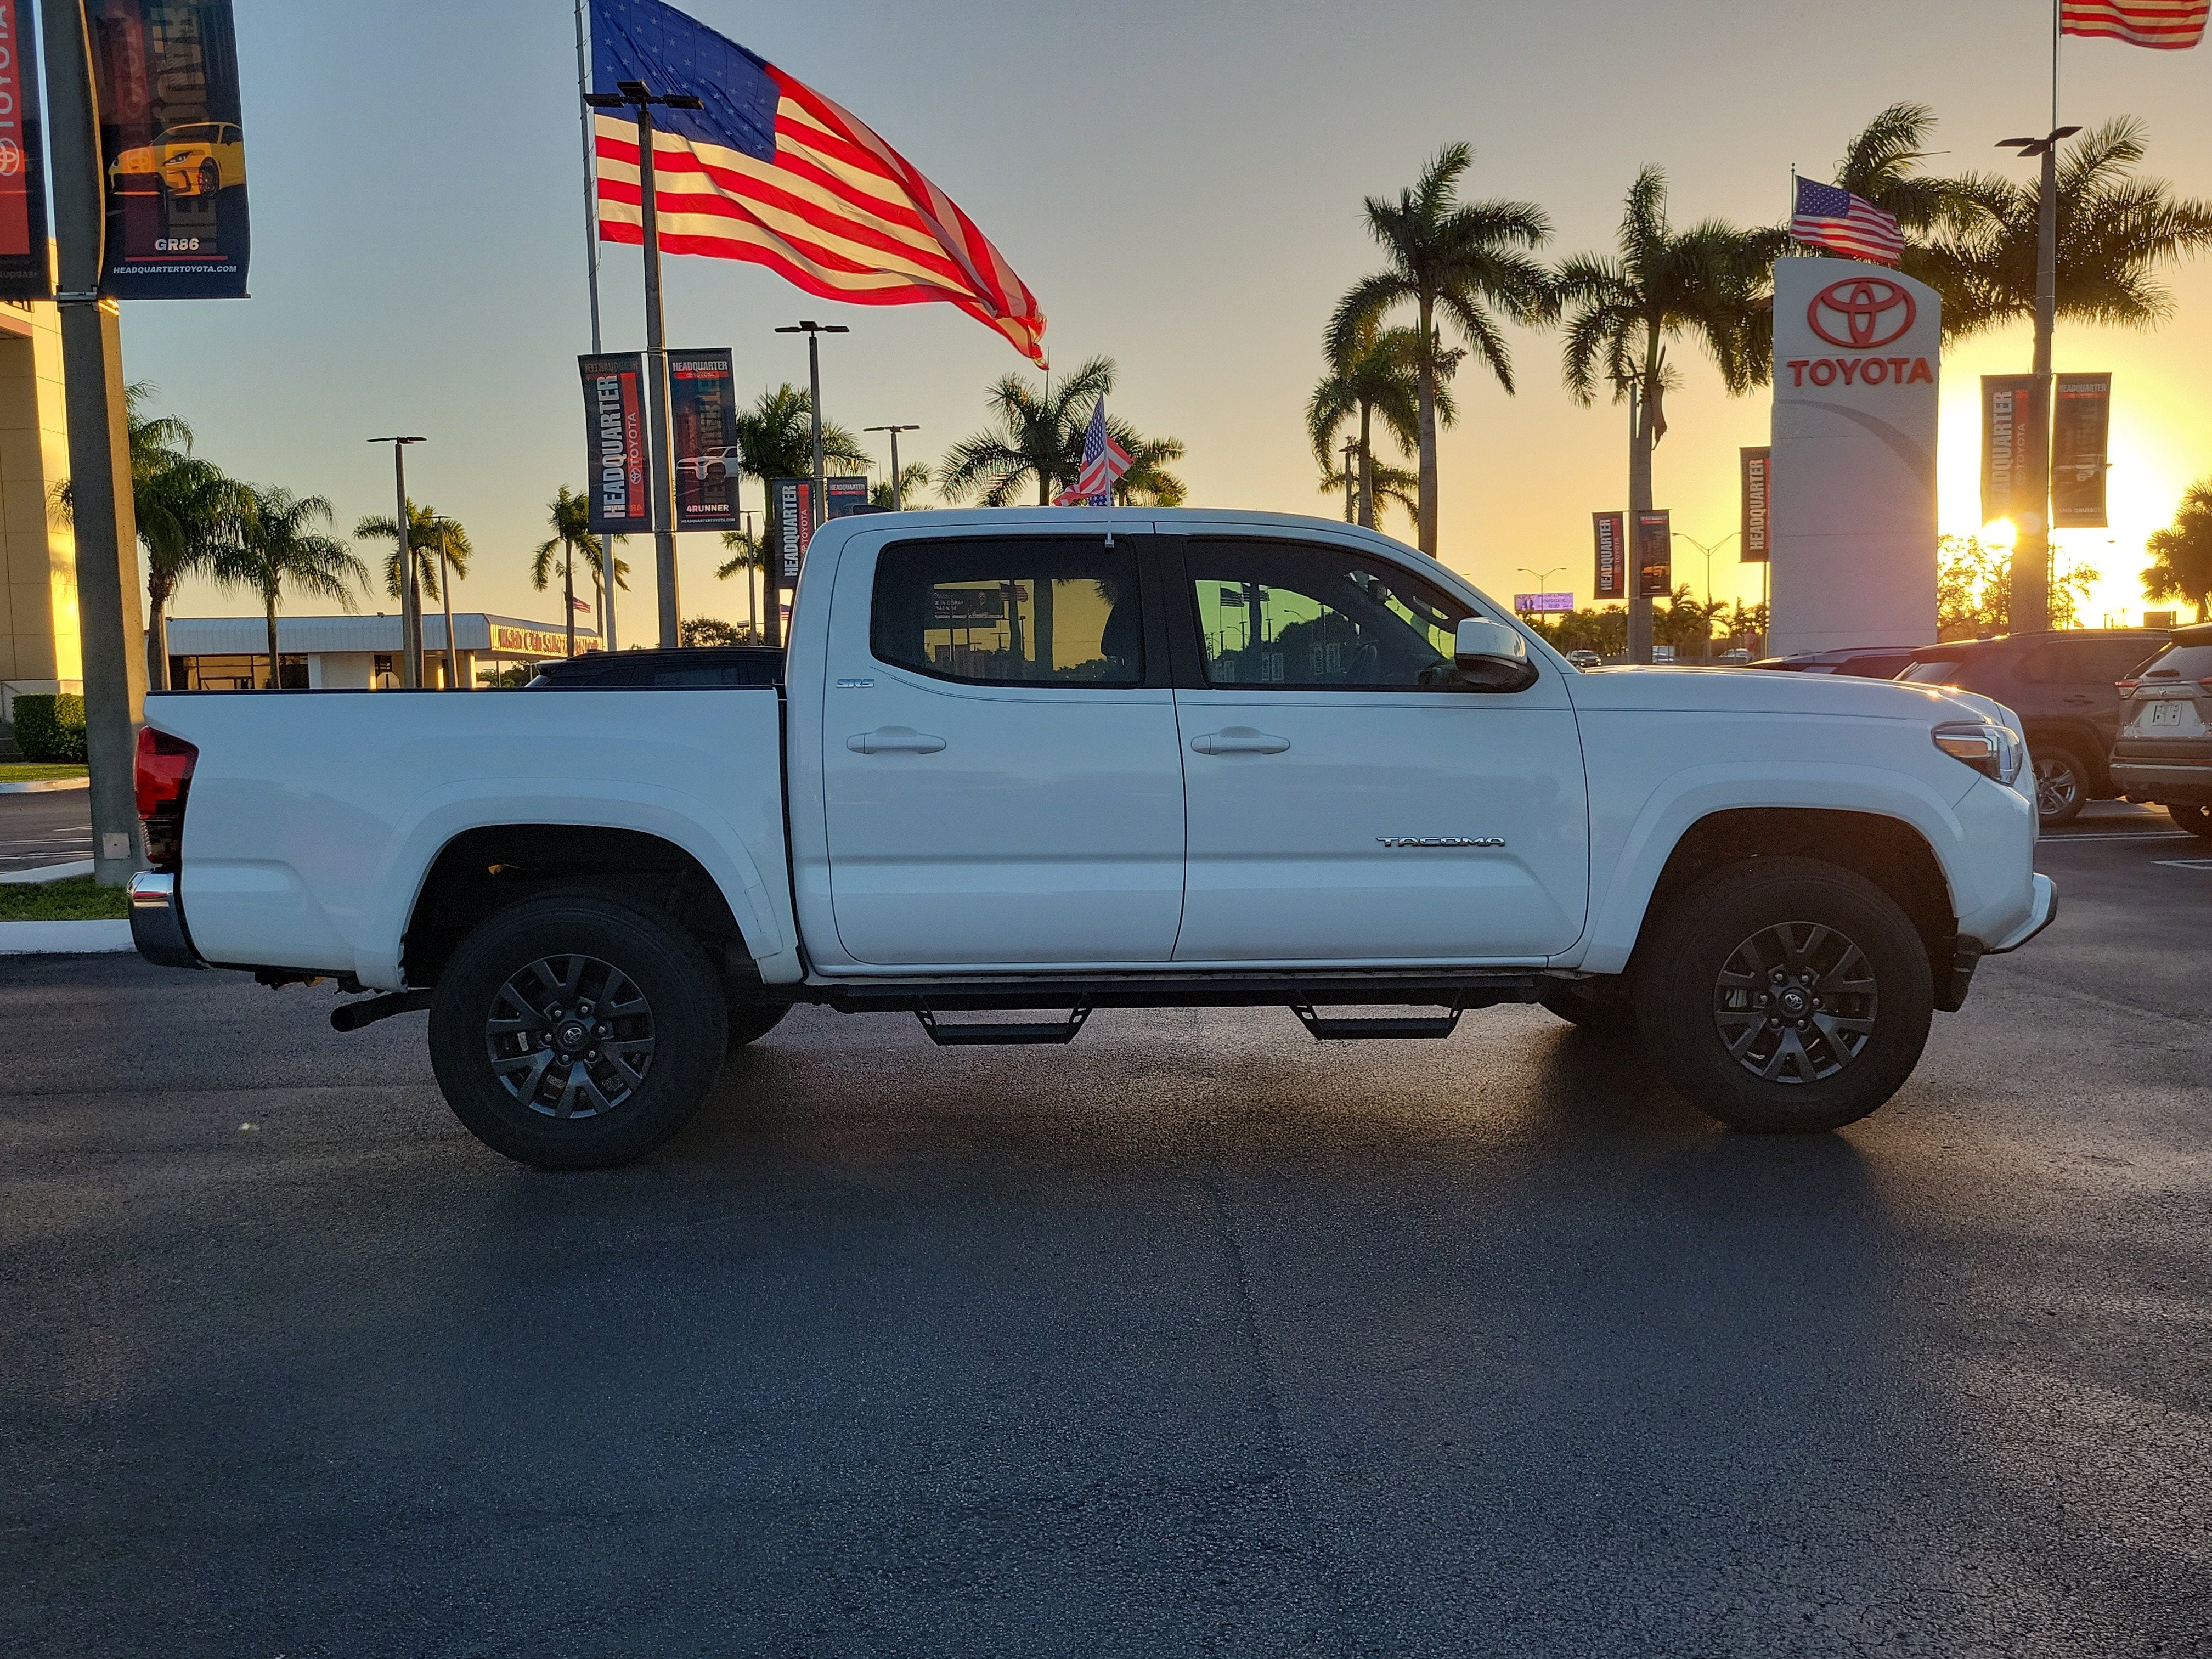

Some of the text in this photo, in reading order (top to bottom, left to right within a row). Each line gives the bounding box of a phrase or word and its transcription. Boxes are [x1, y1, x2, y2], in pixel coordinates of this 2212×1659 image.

[155, 238, 199, 251] GR86
[673, 361, 728, 371] HEADQUARTER
[1787, 357, 1934, 387] TOYOTA
[2059, 384, 2106, 392] HEADQUARTER
[597, 375, 627, 518] HEADQUARTER
[628, 412, 639, 466] TOYOTA
[1991, 391, 2013, 501] ADQUARTER
[2017, 423, 2025, 469] TOYOTA
[686, 504, 729, 512] 4RUNNER
[1750, 459, 1766, 550] HEADQUARTER
[782, 485, 799, 576] HEADQUARTER
[1599, 519, 1613, 590] HEADQUARTER
[836, 679, 874, 688] SR5
[1375, 837, 1505, 847] TACOMA
